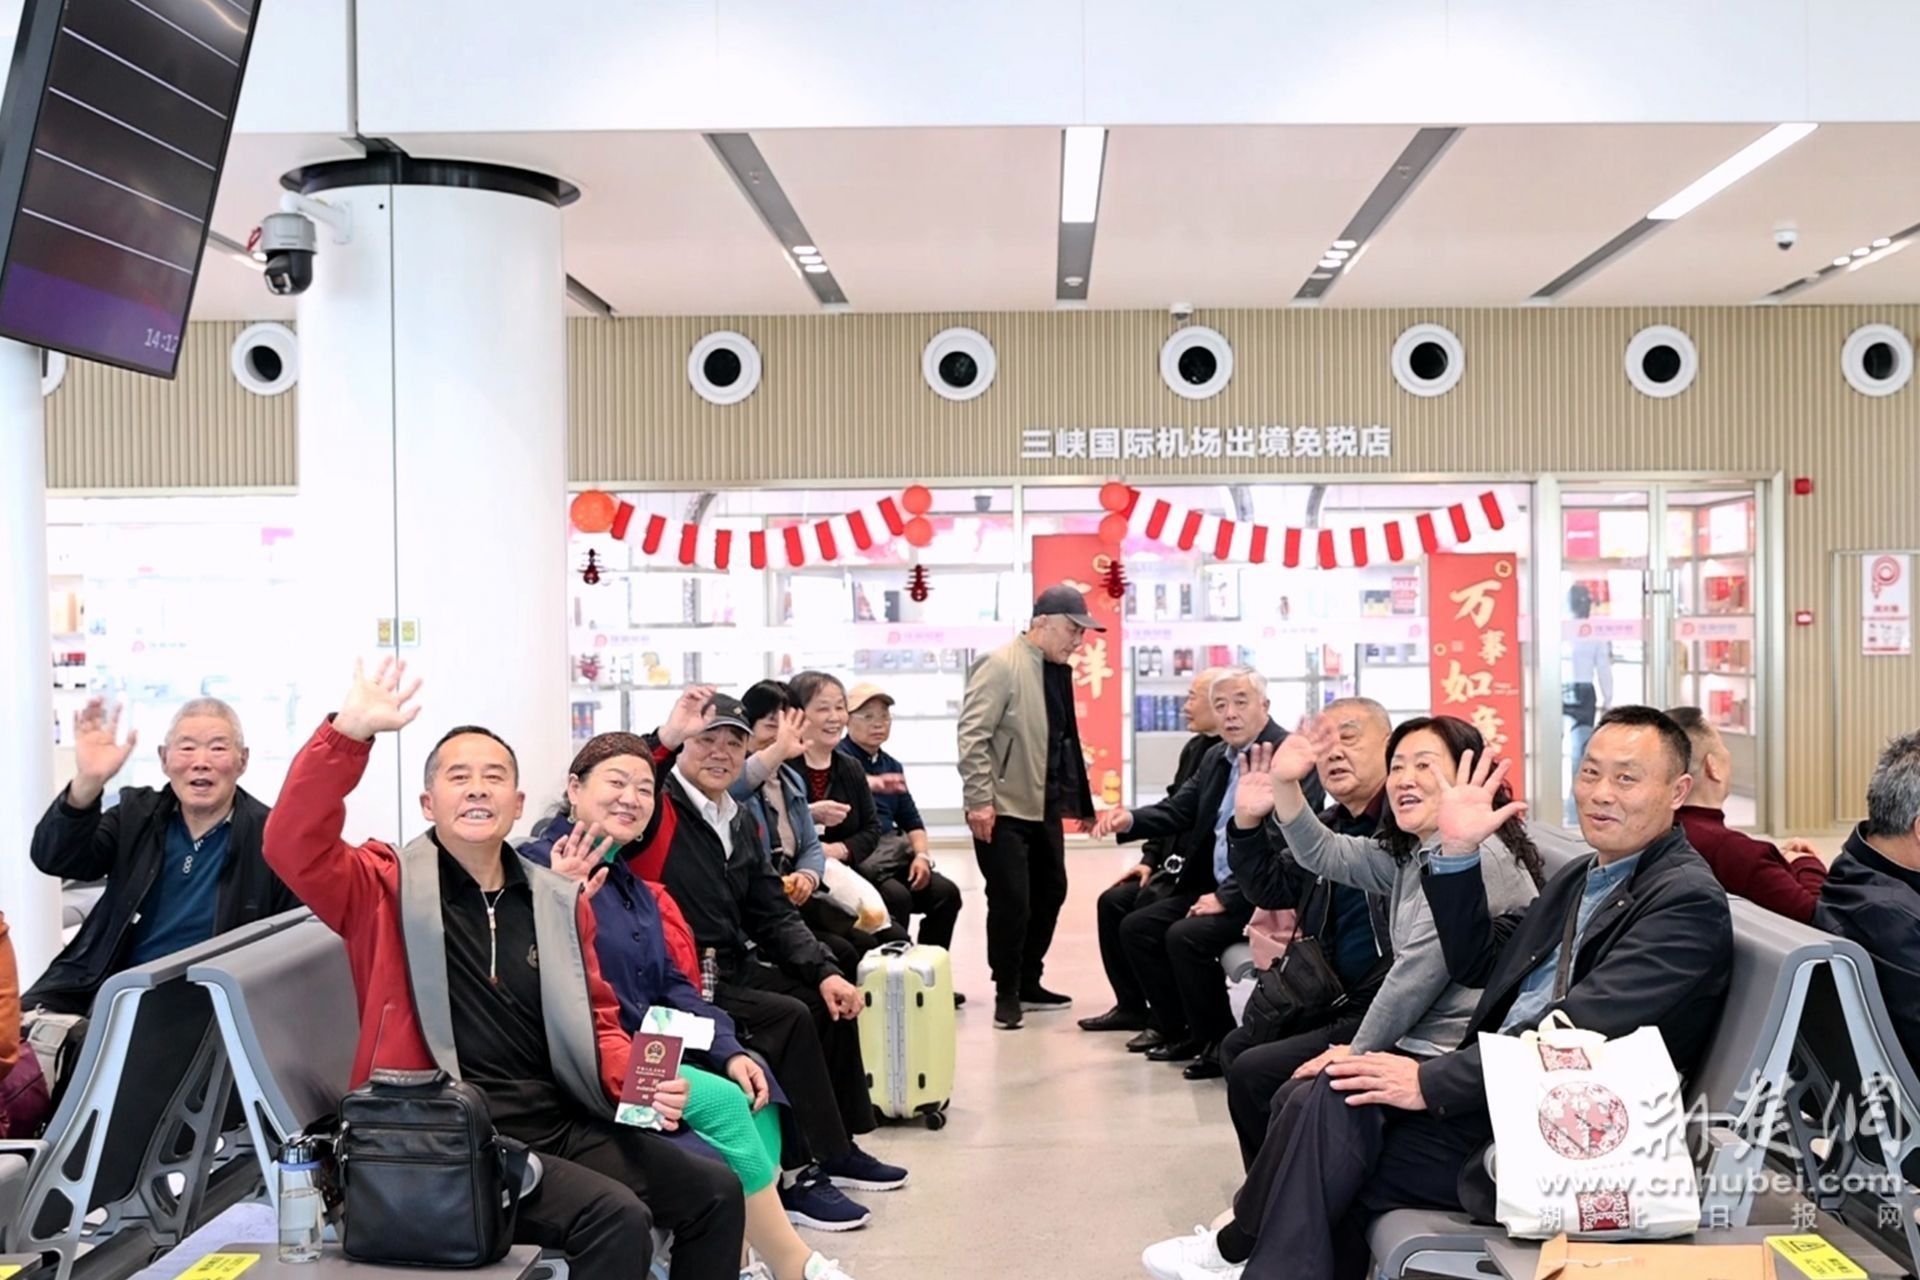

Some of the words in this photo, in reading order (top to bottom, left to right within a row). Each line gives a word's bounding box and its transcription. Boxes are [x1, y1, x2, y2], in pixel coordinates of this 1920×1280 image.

[1020, 425, 1392, 460] 三峡国际机场出境免税店
